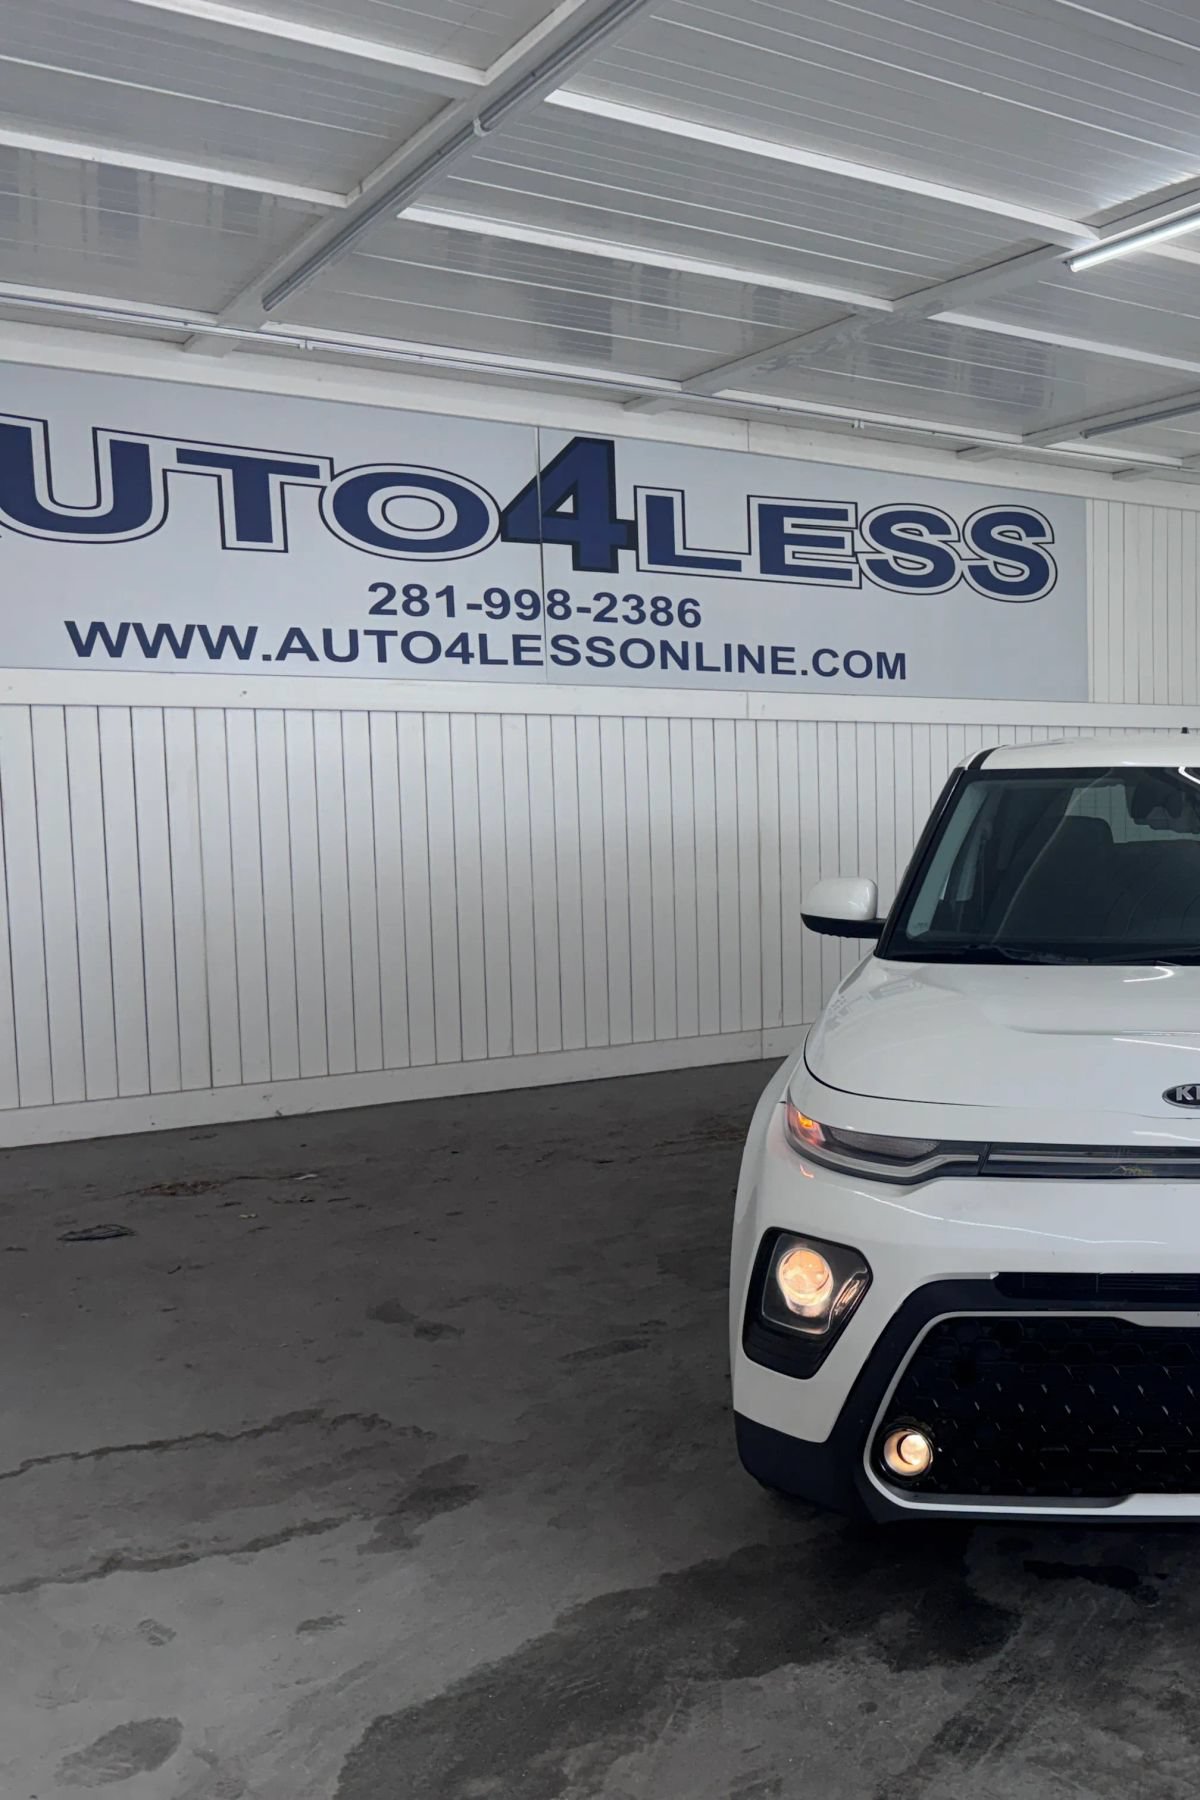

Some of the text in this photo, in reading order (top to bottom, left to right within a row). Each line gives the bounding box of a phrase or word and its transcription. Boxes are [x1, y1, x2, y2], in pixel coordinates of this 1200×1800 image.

[0, 412, 1058, 604] UTO4LESS
[368, 581, 702, 629] 281-998-2386
[63, 620, 907, 681] WWW.AUTO4LESSONLINE.COM
